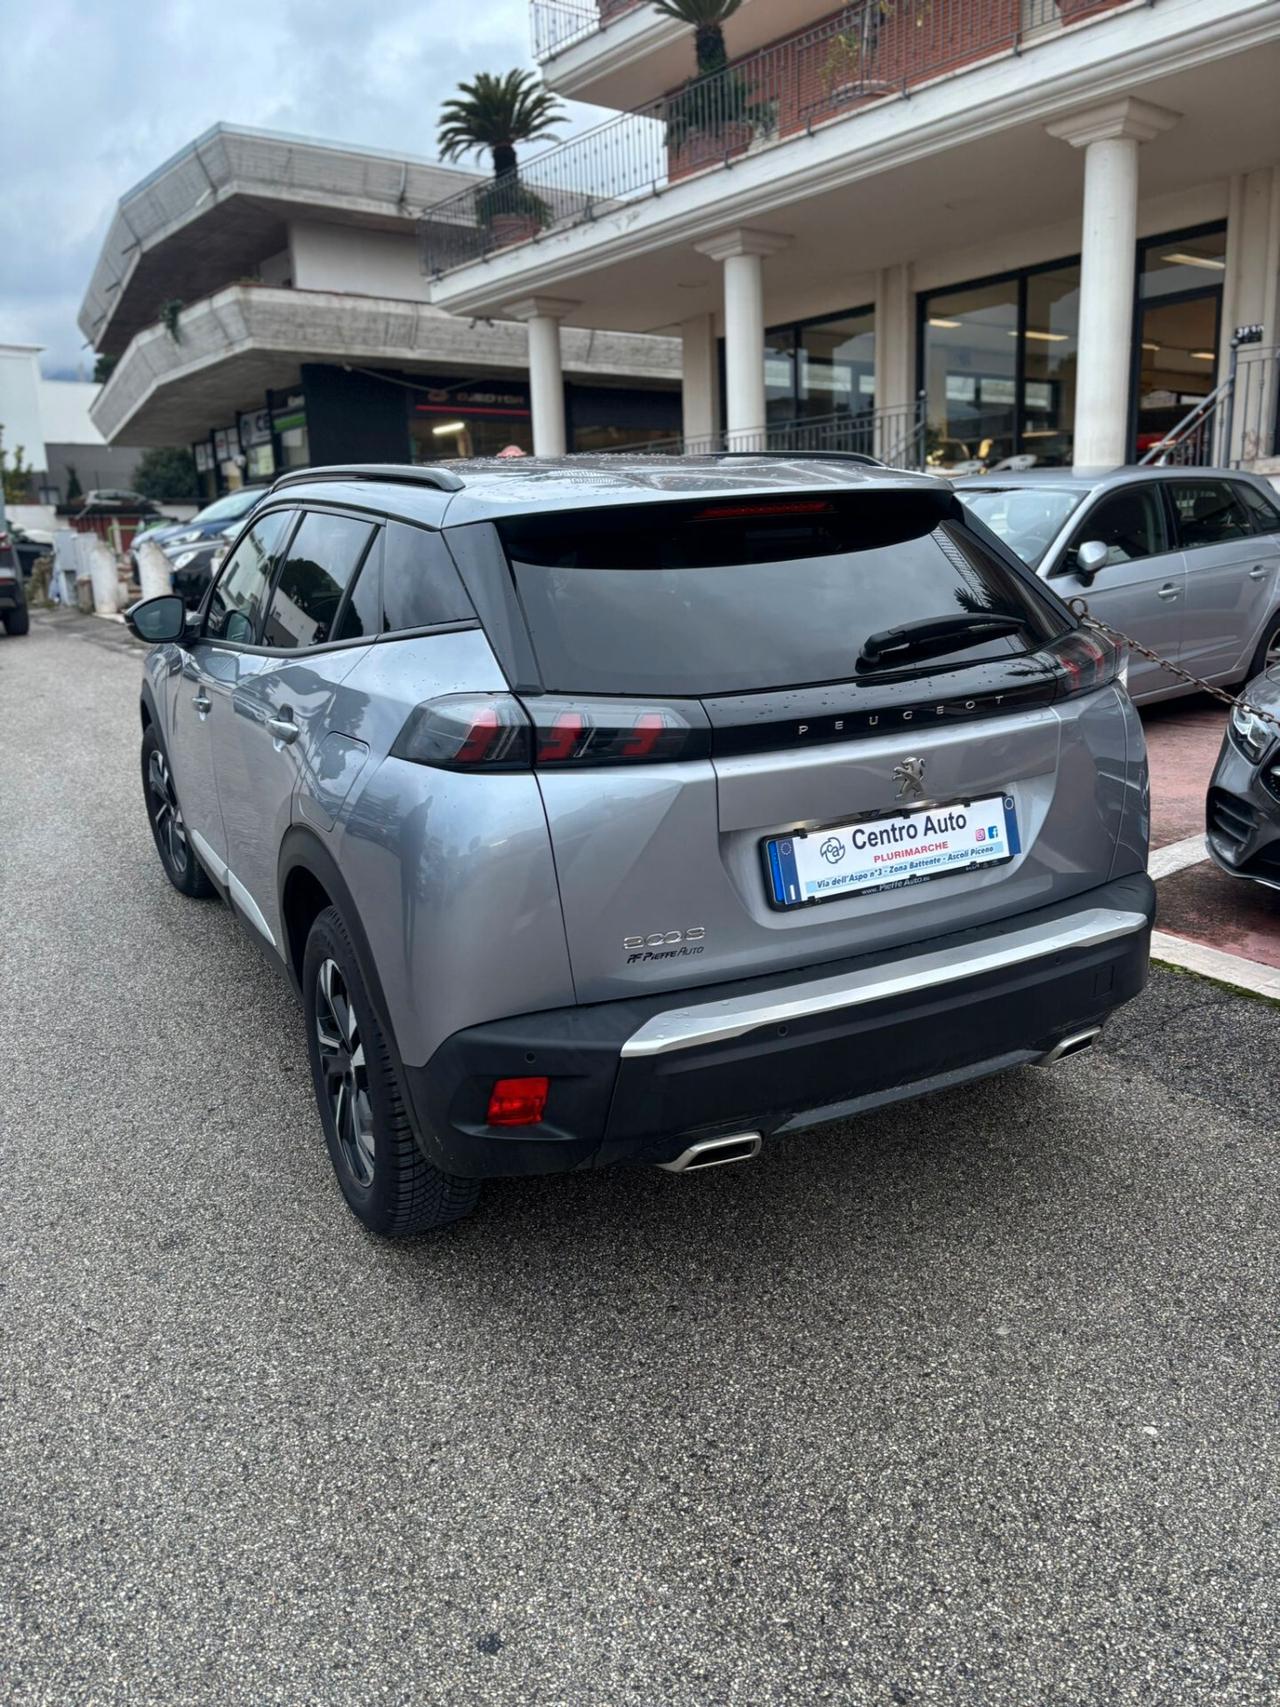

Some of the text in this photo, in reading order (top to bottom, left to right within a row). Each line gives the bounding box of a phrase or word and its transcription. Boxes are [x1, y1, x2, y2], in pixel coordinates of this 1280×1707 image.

[798, 695, 1004, 735] PEUGEOT
[852, 812, 967, 850] Centro Auto
[817, 879, 830, 889] Via
[889, 864, 907, 874] Zona
[909, 857, 941, 871] Battente
[947, 850, 969, 861] Ascoli
[970, 846, 994, 856] Piceno
